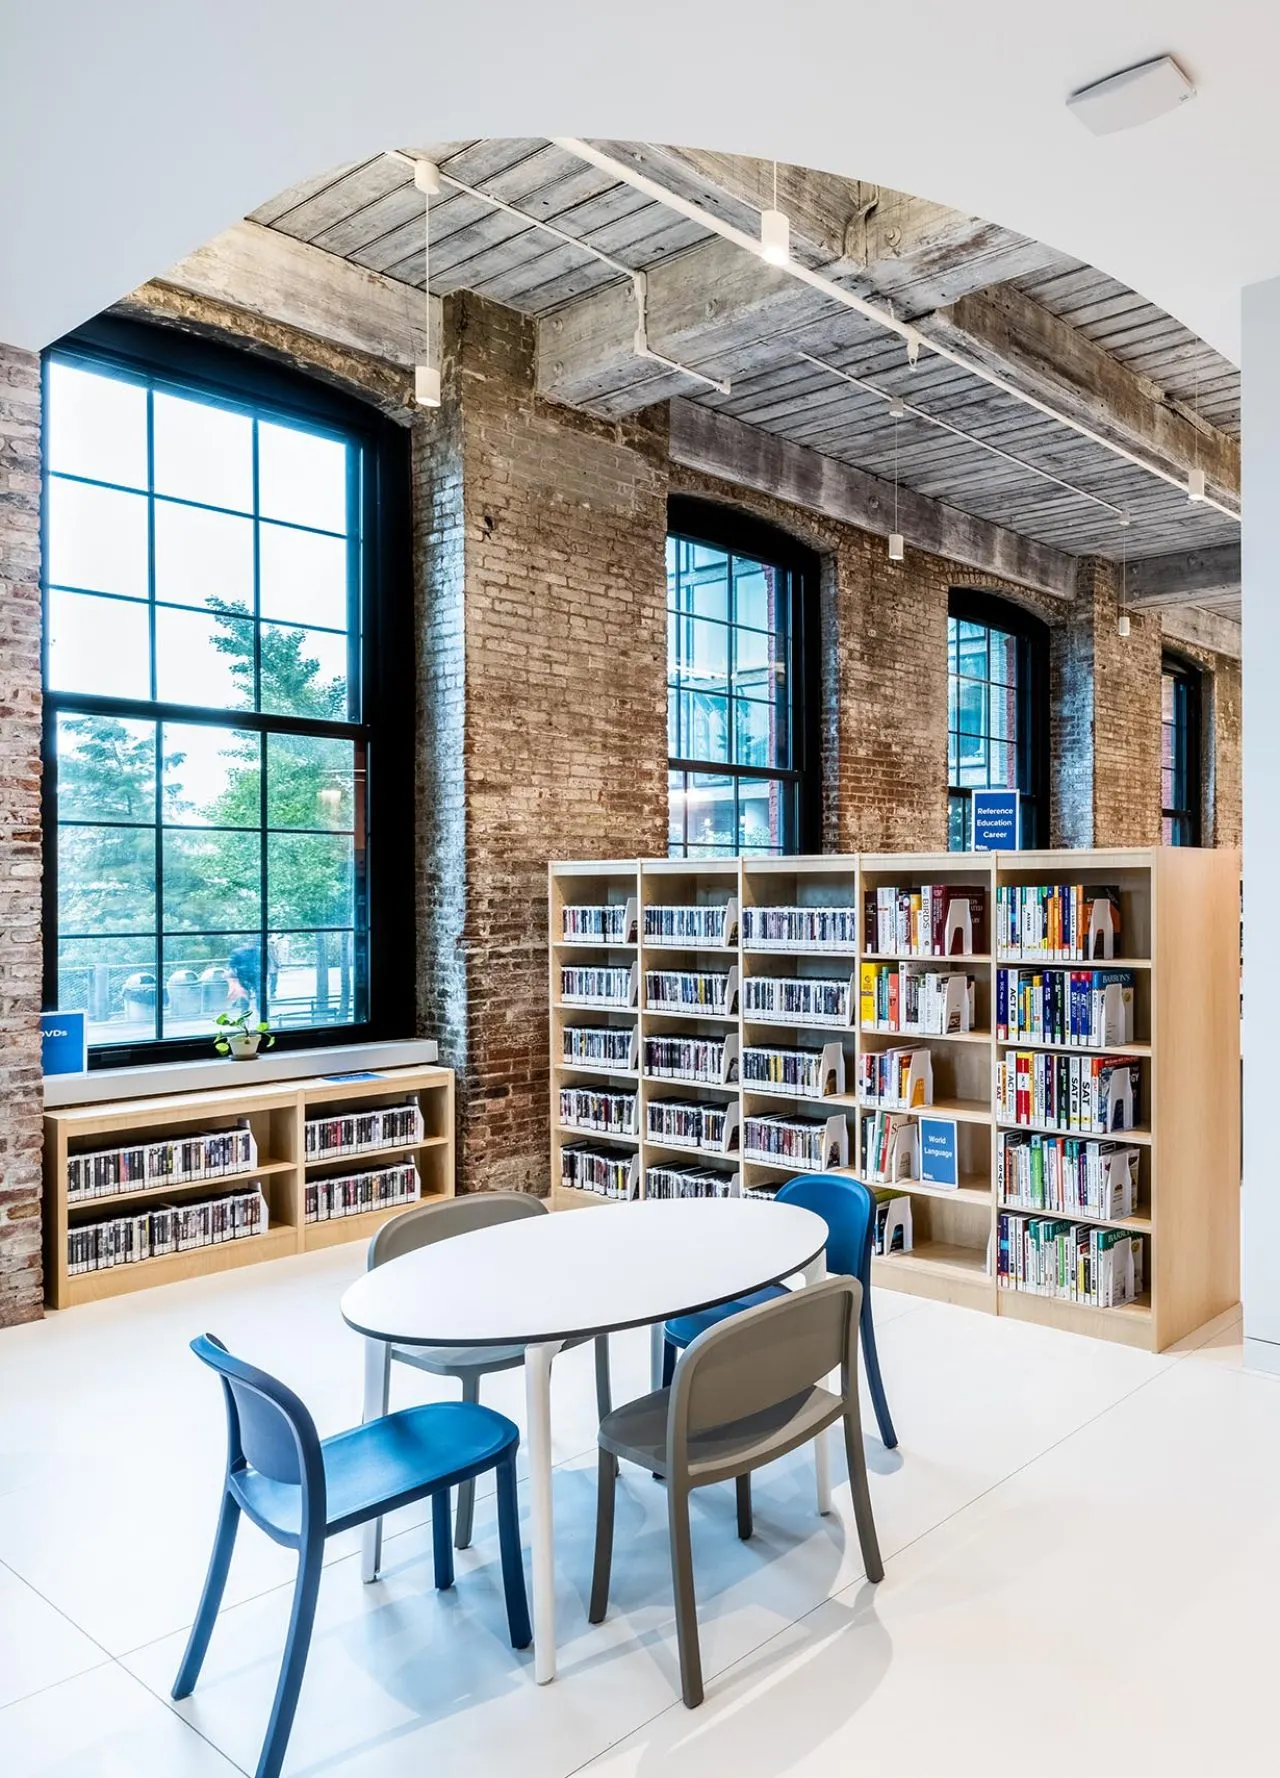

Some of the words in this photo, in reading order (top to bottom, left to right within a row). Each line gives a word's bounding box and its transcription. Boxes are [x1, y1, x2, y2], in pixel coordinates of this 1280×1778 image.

[977, 807, 1013, 815] Reference
[1082, 1081, 1090, 1106] SAT
[928, 1135, 946, 1144] World
[924, 1147, 952, 1158] Language
